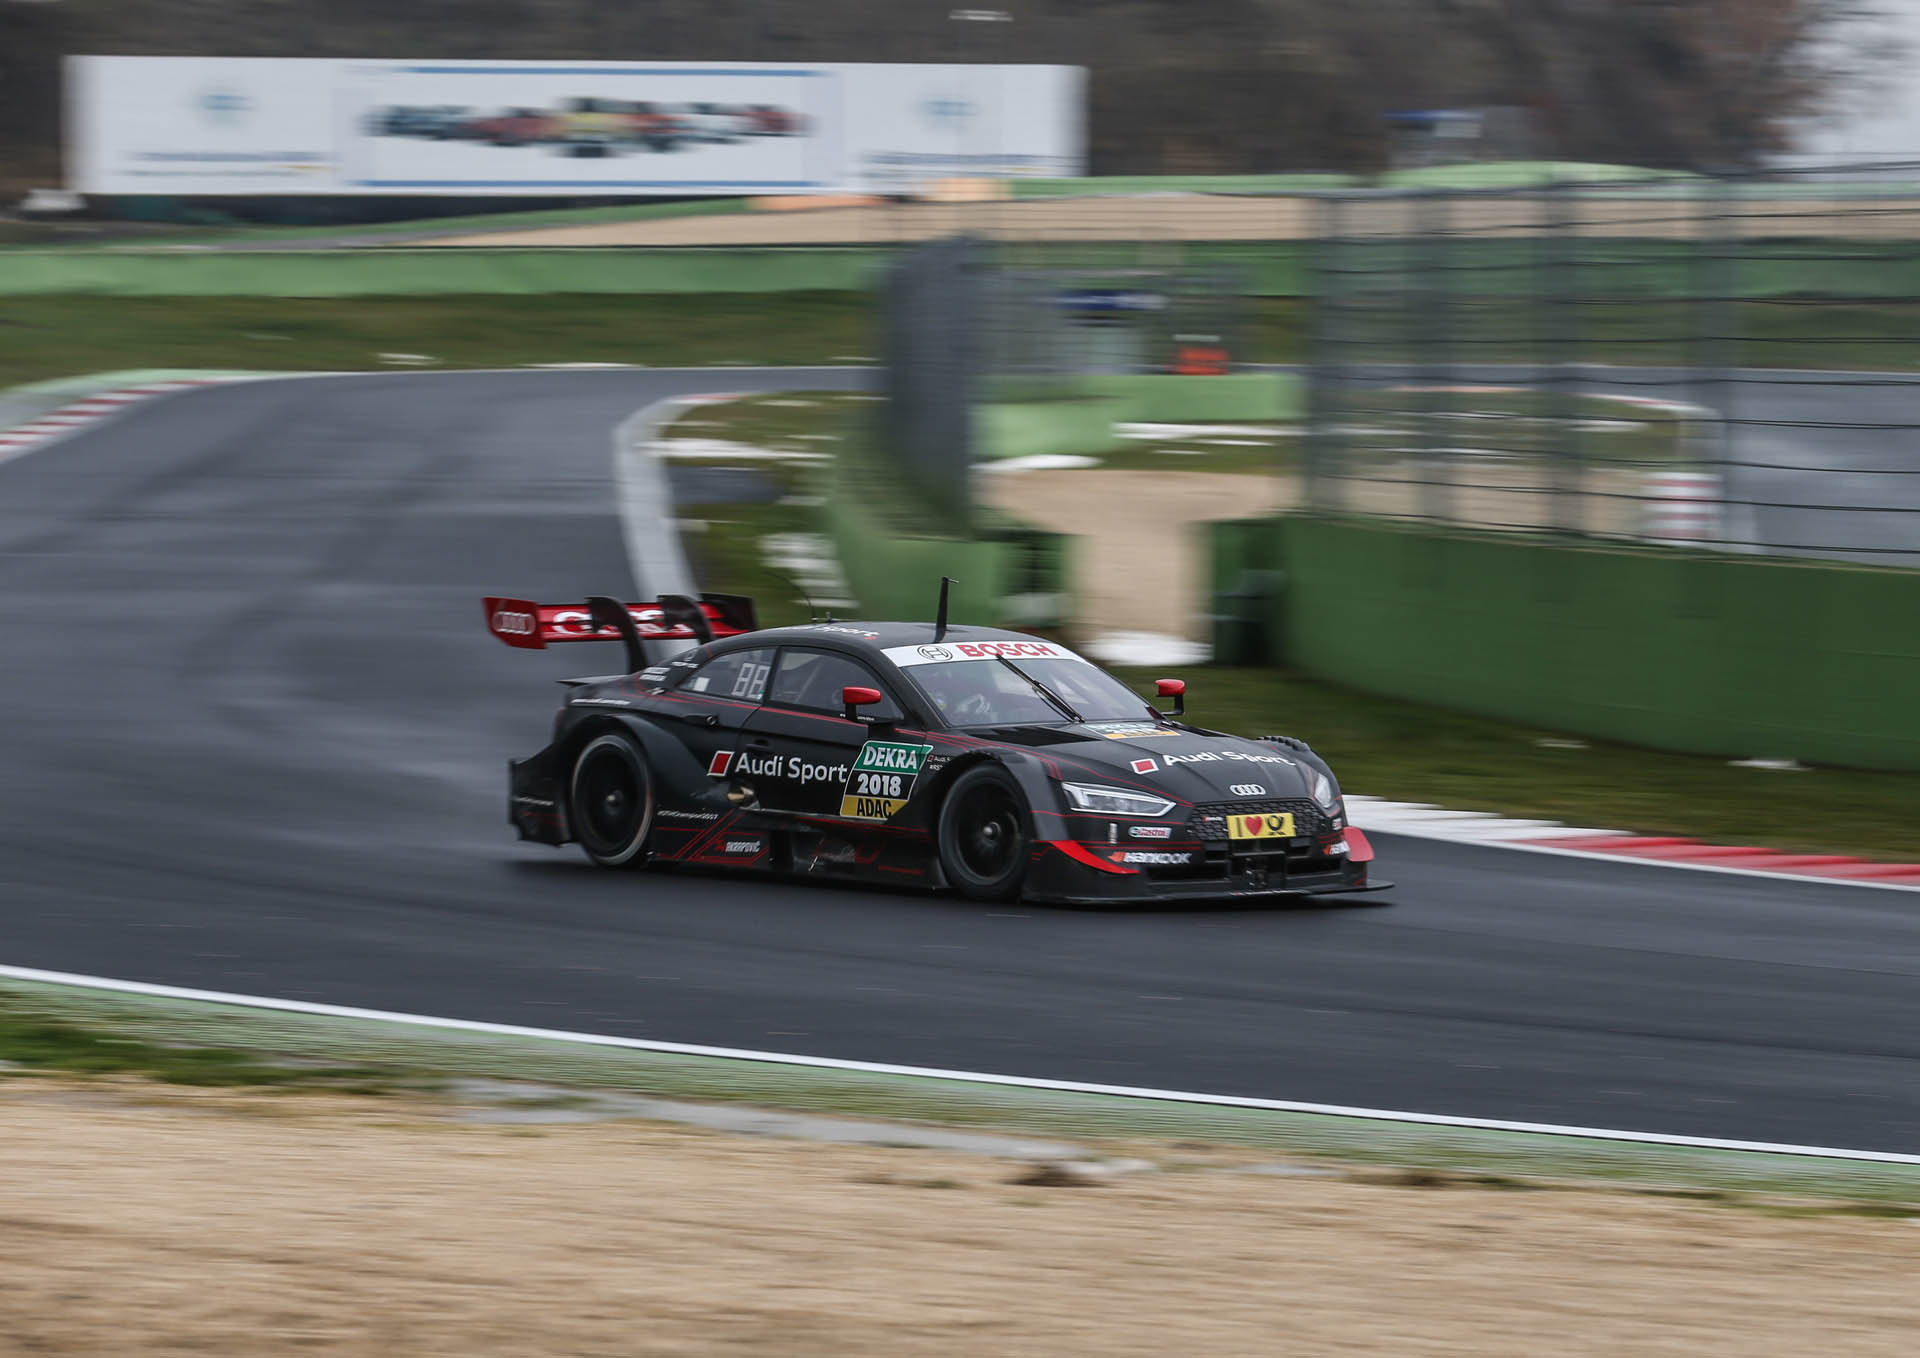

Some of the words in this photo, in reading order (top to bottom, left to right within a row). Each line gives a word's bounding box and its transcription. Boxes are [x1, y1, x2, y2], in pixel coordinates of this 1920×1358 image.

[957, 642, 1058, 657] BOSCH
[863, 746, 918, 769] DEKRA
[1164, 752, 1223, 766] Audi
[1223, 751, 1297, 766] Sport
[735, 753, 784, 777] Audi
[788, 757, 847, 785] Sport
[857, 773, 902, 797] 2018
[856, 797, 893, 818] ADAC
